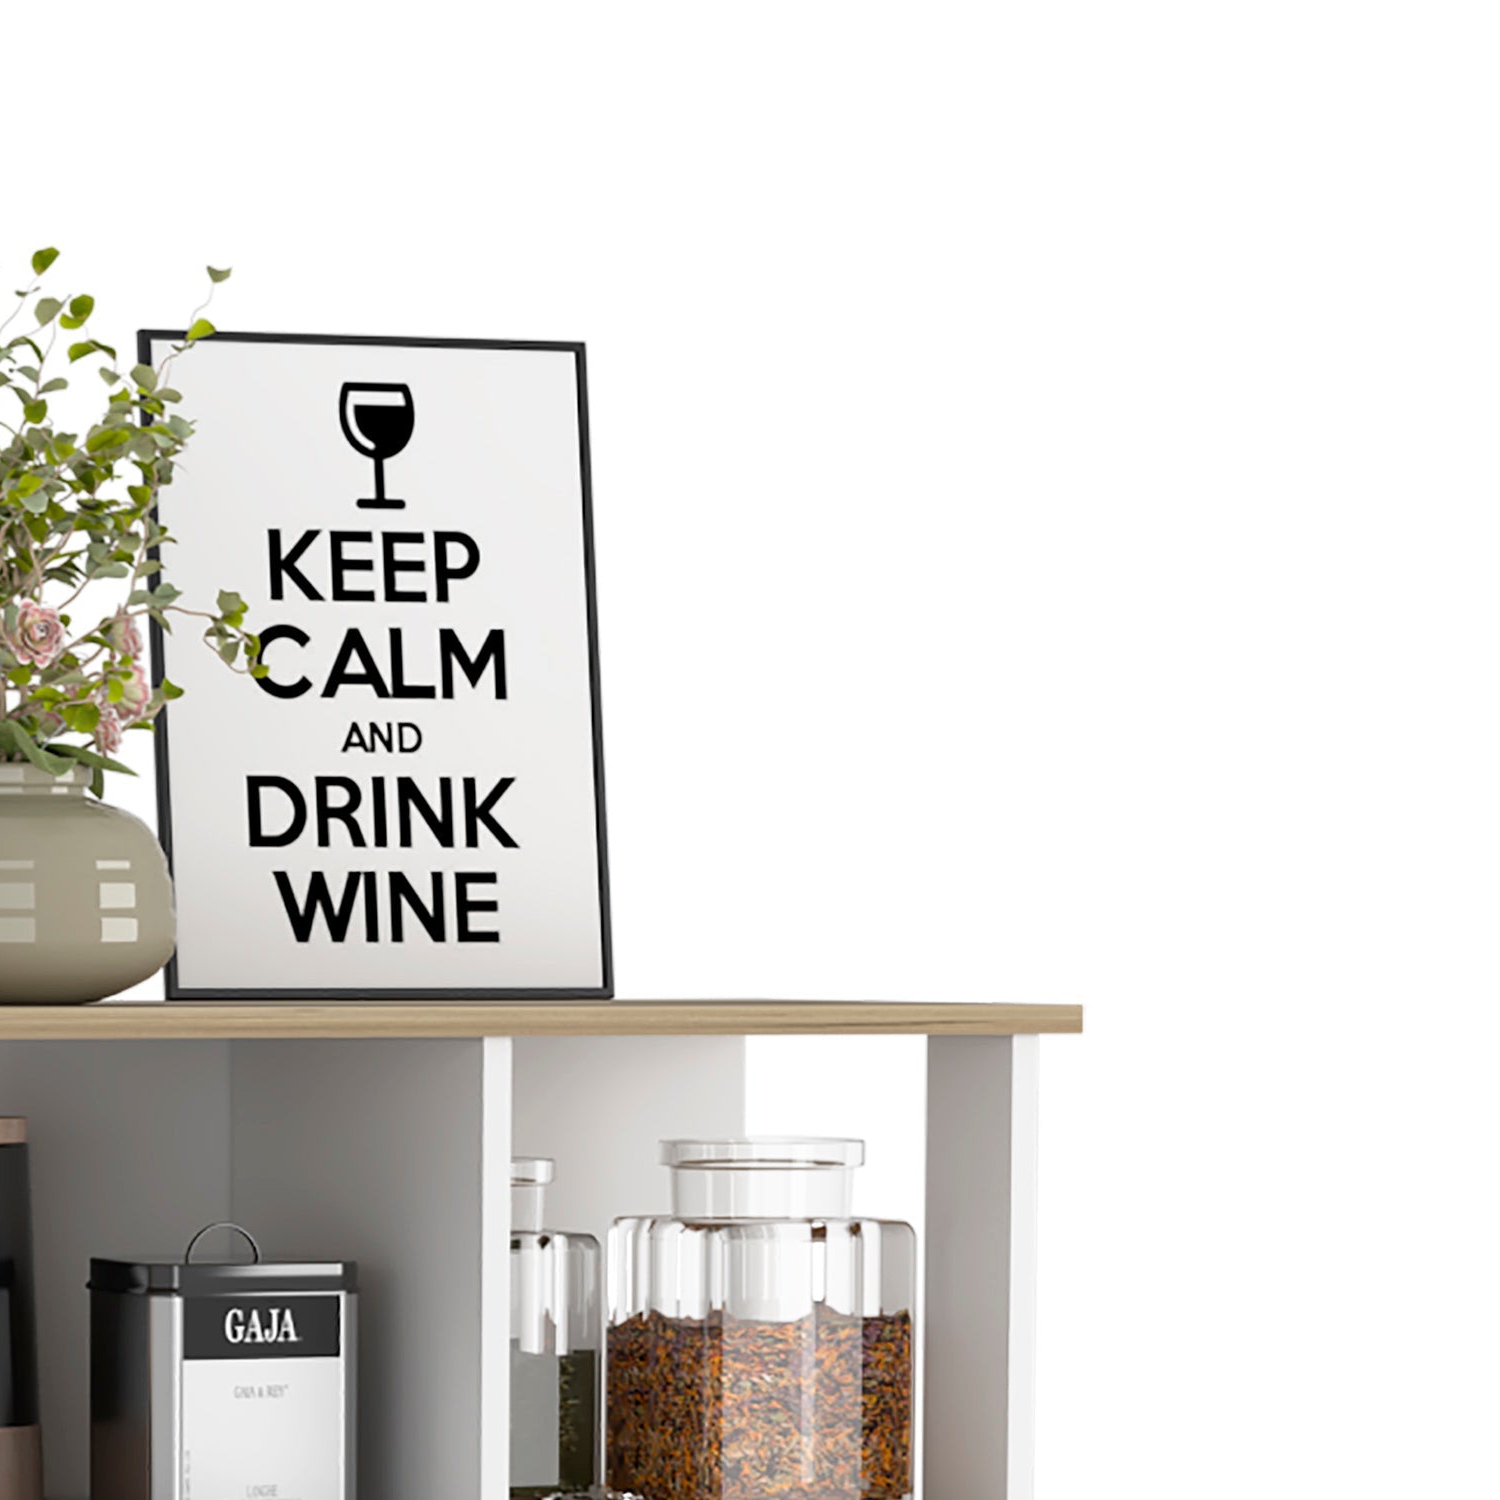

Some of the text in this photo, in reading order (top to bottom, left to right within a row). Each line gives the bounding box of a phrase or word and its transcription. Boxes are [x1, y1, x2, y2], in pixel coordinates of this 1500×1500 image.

[268, 529, 480, 602] KEEP
[255, 624, 507, 700] CALM
[341, 721, 422, 753] AND
[246, 775, 520, 849] DRINK
[272, 871, 500, 943] WINE
[224, 1308, 300, 1344] GAJA
